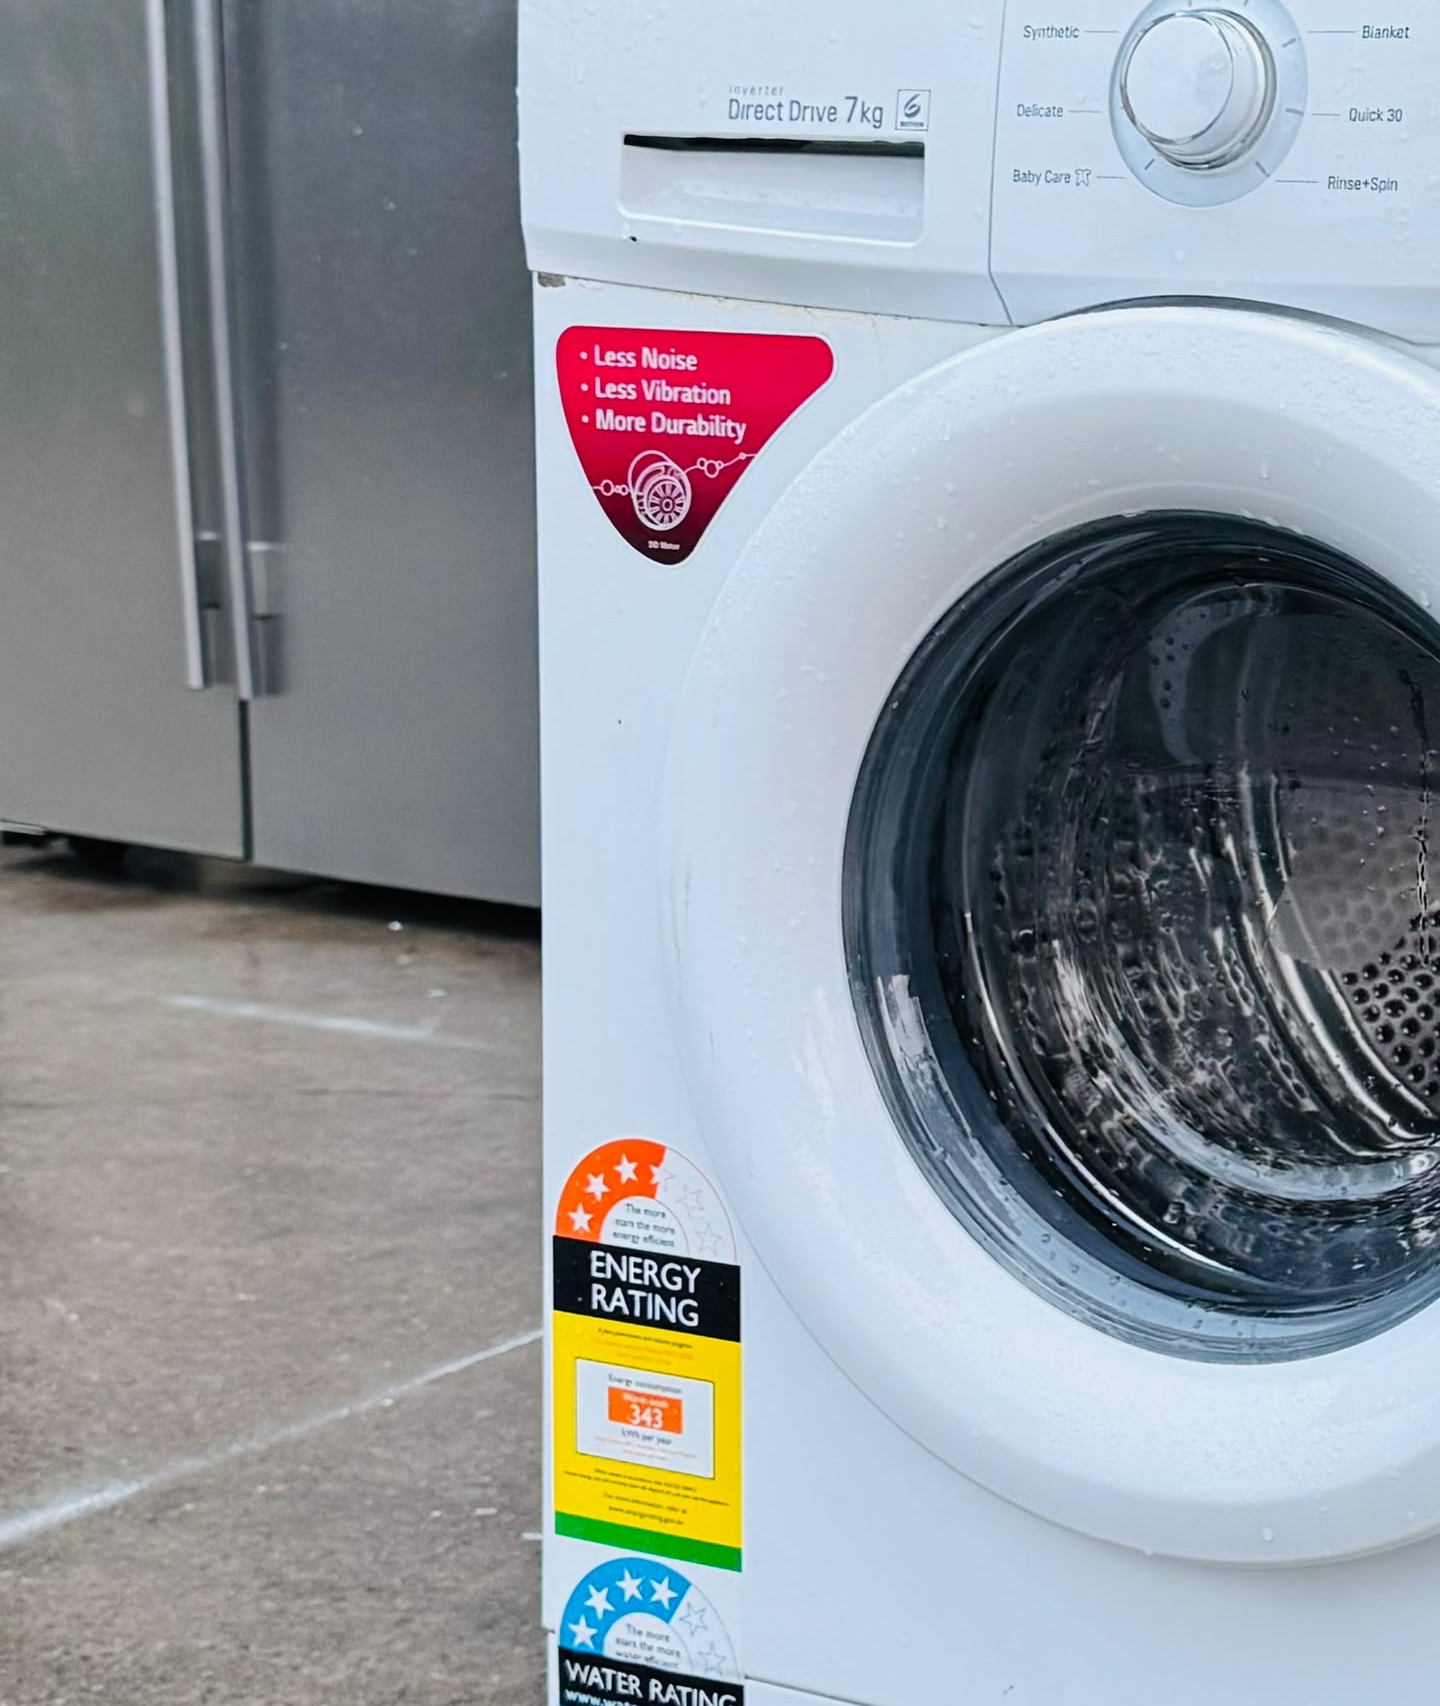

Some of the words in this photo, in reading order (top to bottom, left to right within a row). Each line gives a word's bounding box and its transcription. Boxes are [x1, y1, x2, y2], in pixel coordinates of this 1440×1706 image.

[1023, 25, 1080, 41] Synthetic
[1361, 25, 1410, 40] Blanket
[728, 98, 784, 121] Direct
[789, 100, 838, 122] Drive
[844, 96, 884, 129] 7kg
[1016, 104, 1064, 118] Delicate
[1349, 107, 1385, 124] Quick
[1387, 108, 1403, 122] 30
[1012, 168, 1043, 185] Baby
[1045, 170, 1072, 184] Care
[1327, 175, 1400, 192] Rinse+Spin
[594, 345, 636, 367] Less
[641, 347, 698, 371] Noise
[594, 377, 637, 400] Less
[641, 379, 731, 405] Vibration
[595, 409, 646, 432] More
[651, 411, 747, 444] Durability
[590, 1250, 701, 1294] ENERGY
[591, 1283, 699, 1327] RATING
[630, 1403, 663, 1429] 343
[564, 1659, 643, 1698] WATER
